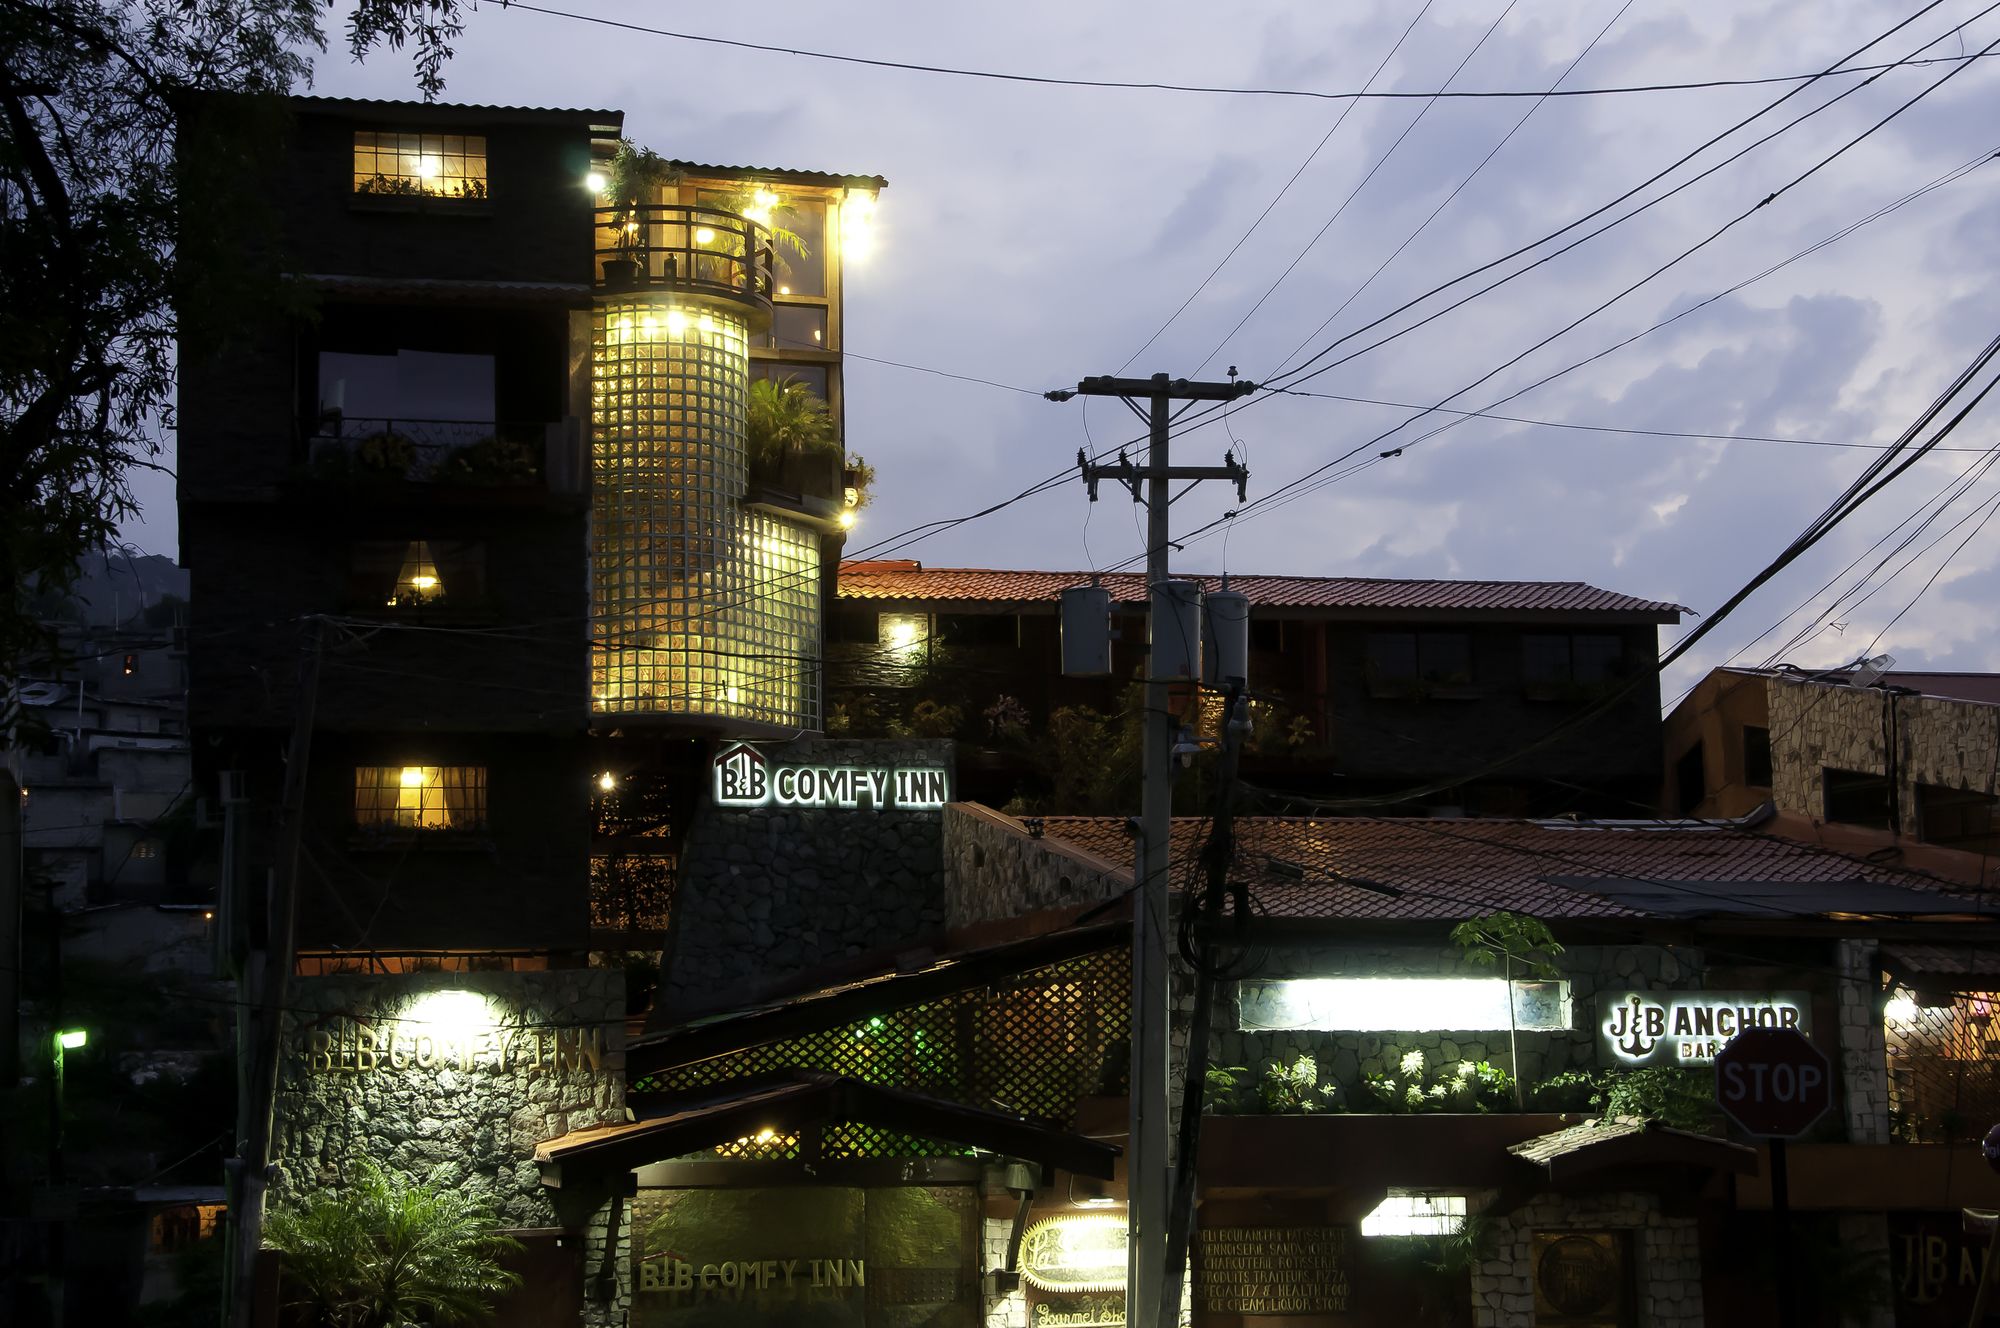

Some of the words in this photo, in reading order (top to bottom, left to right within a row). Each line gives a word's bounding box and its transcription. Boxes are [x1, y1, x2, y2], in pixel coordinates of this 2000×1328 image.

[721, 752, 767, 800] B&B
[778, 768, 888, 803] COMFY
[897, 770, 946, 804] INN
[1674, 1006, 1800, 1037] ANCHOR
[528, 1027, 601, 1073] INN
[1682, 1042, 1716, 1058] BAR
[1724, 1061, 1823, 1104] STOP
[700, 1260, 798, 1289] COMFY
[808, 1258, 865, 1287] INN
[1317, 1270, 1347, 1283] PIZZA
[1278, 1284, 1321, 1297] HEALTH
[1325, 1284, 1351, 1297] FOOD
[1100, 1304, 1127, 1324] Sho
[1316, 1298, 1347, 1312] STORE
